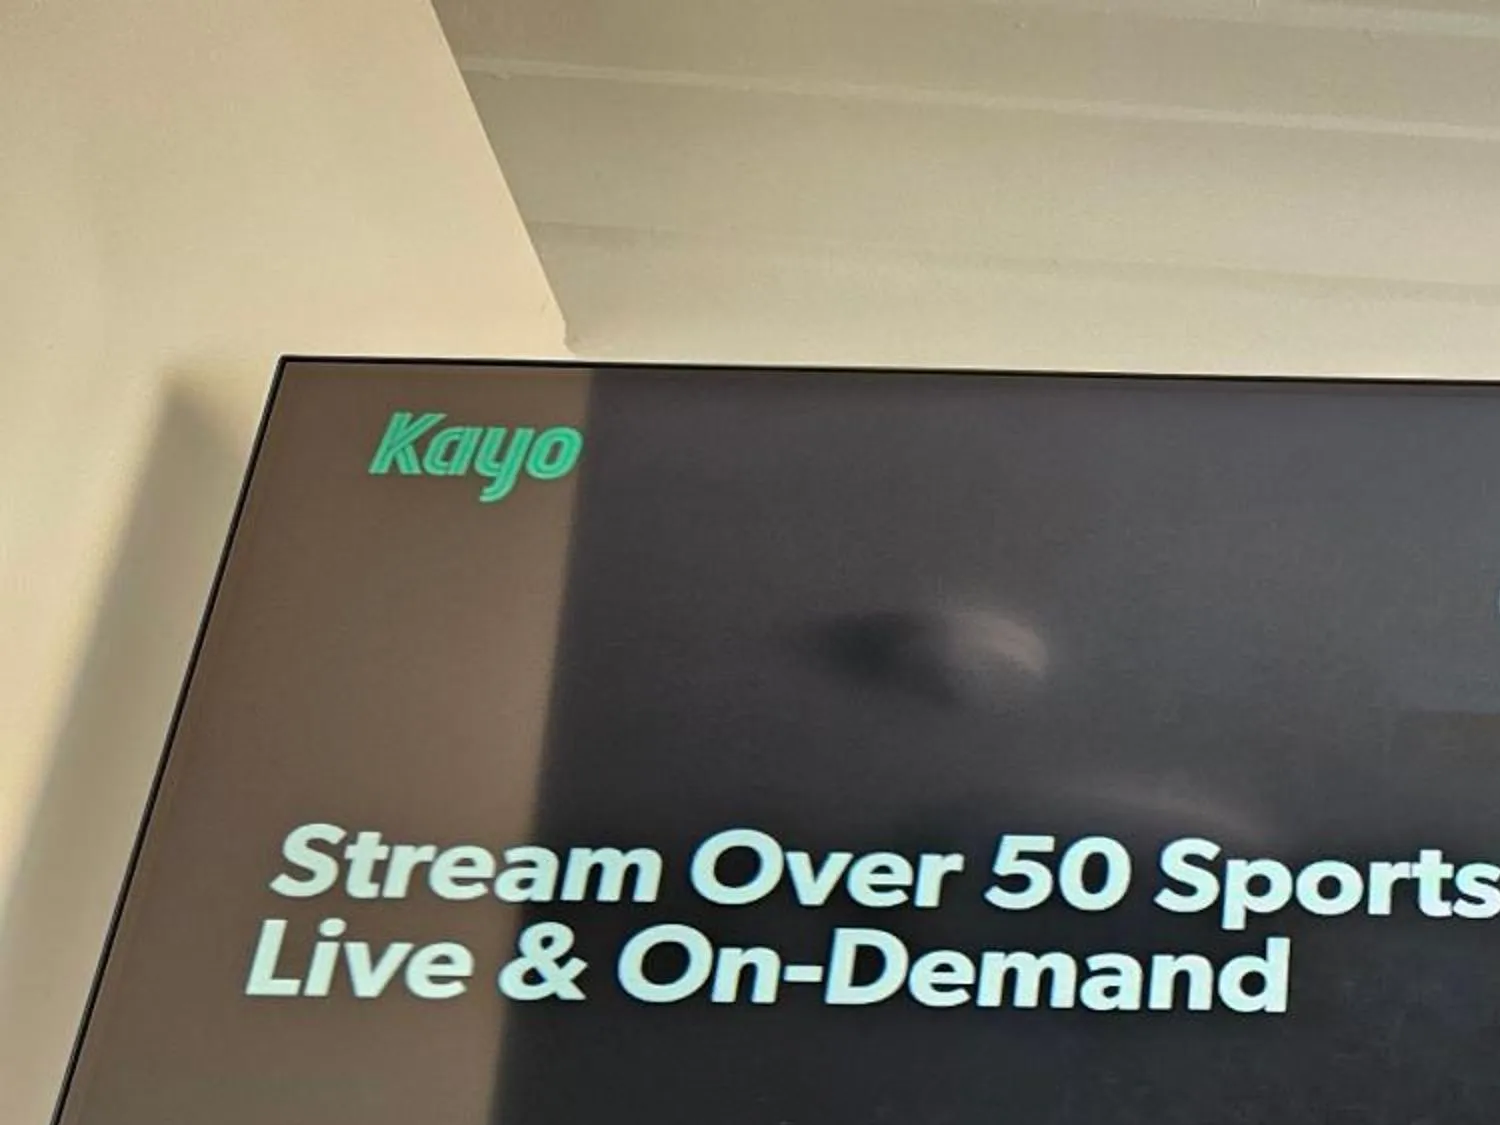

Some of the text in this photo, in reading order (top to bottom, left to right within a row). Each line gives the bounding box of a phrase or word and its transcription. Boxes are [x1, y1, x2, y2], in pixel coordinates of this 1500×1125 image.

[368, 411, 584, 502] Kayo
[271, 822, 663, 903] Stream
[690, 828, 964, 909] Over
[984, 834, 1132, 912] 50
[246, 917, 1292, 1014] Live & On-Demand
